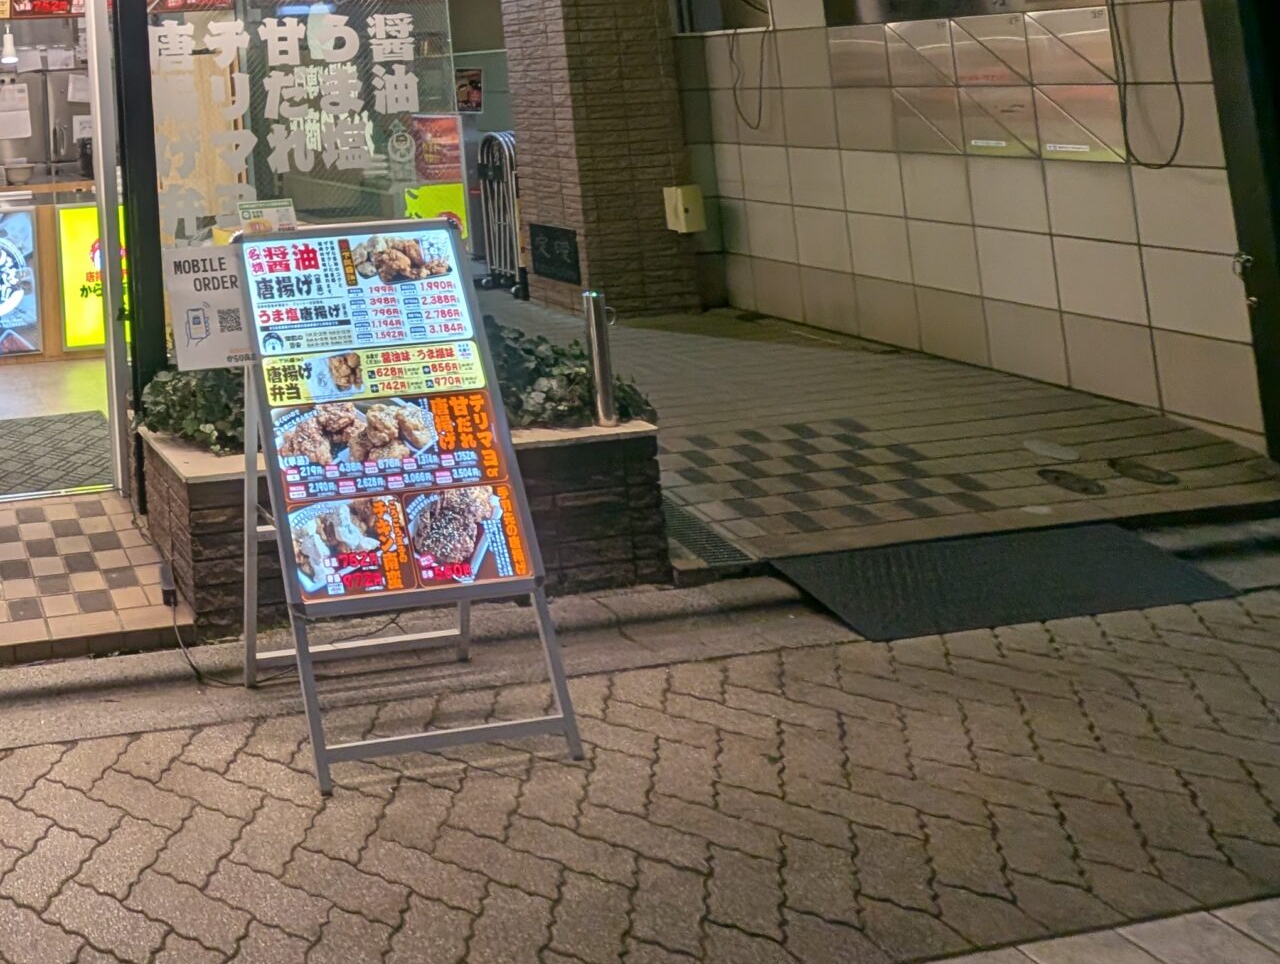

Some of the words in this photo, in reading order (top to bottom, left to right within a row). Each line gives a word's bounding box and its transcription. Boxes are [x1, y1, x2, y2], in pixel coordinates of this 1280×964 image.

[367, 12, 420, 115] 醤油
[257, 16, 316, 174] 甘だれ
[173, 257, 228, 275] MOBILE
[263, 242, 320, 274] 醤油
[193, 275, 240, 292] ORDER
[255, 274, 313, 300] 唐揚げ
[369, 285, 394, 294] 199円
[369, 297, 397, 305] 398円
[258, 304, 341, 325] うま塩唐揚げ
[267, 362, 313, 383] 唐揚げ
[376, 367, 404, 377] 628円
[432, 362, 458, 373] 856円
[379, 380, 407, 391] 742円
[435, 376, 461, 386] 970円
[270, 383, 303, 403] 弁当
[429, 397, 456, 451] 唐揚げ
[449, 396, 478, 449] 甘だれ
